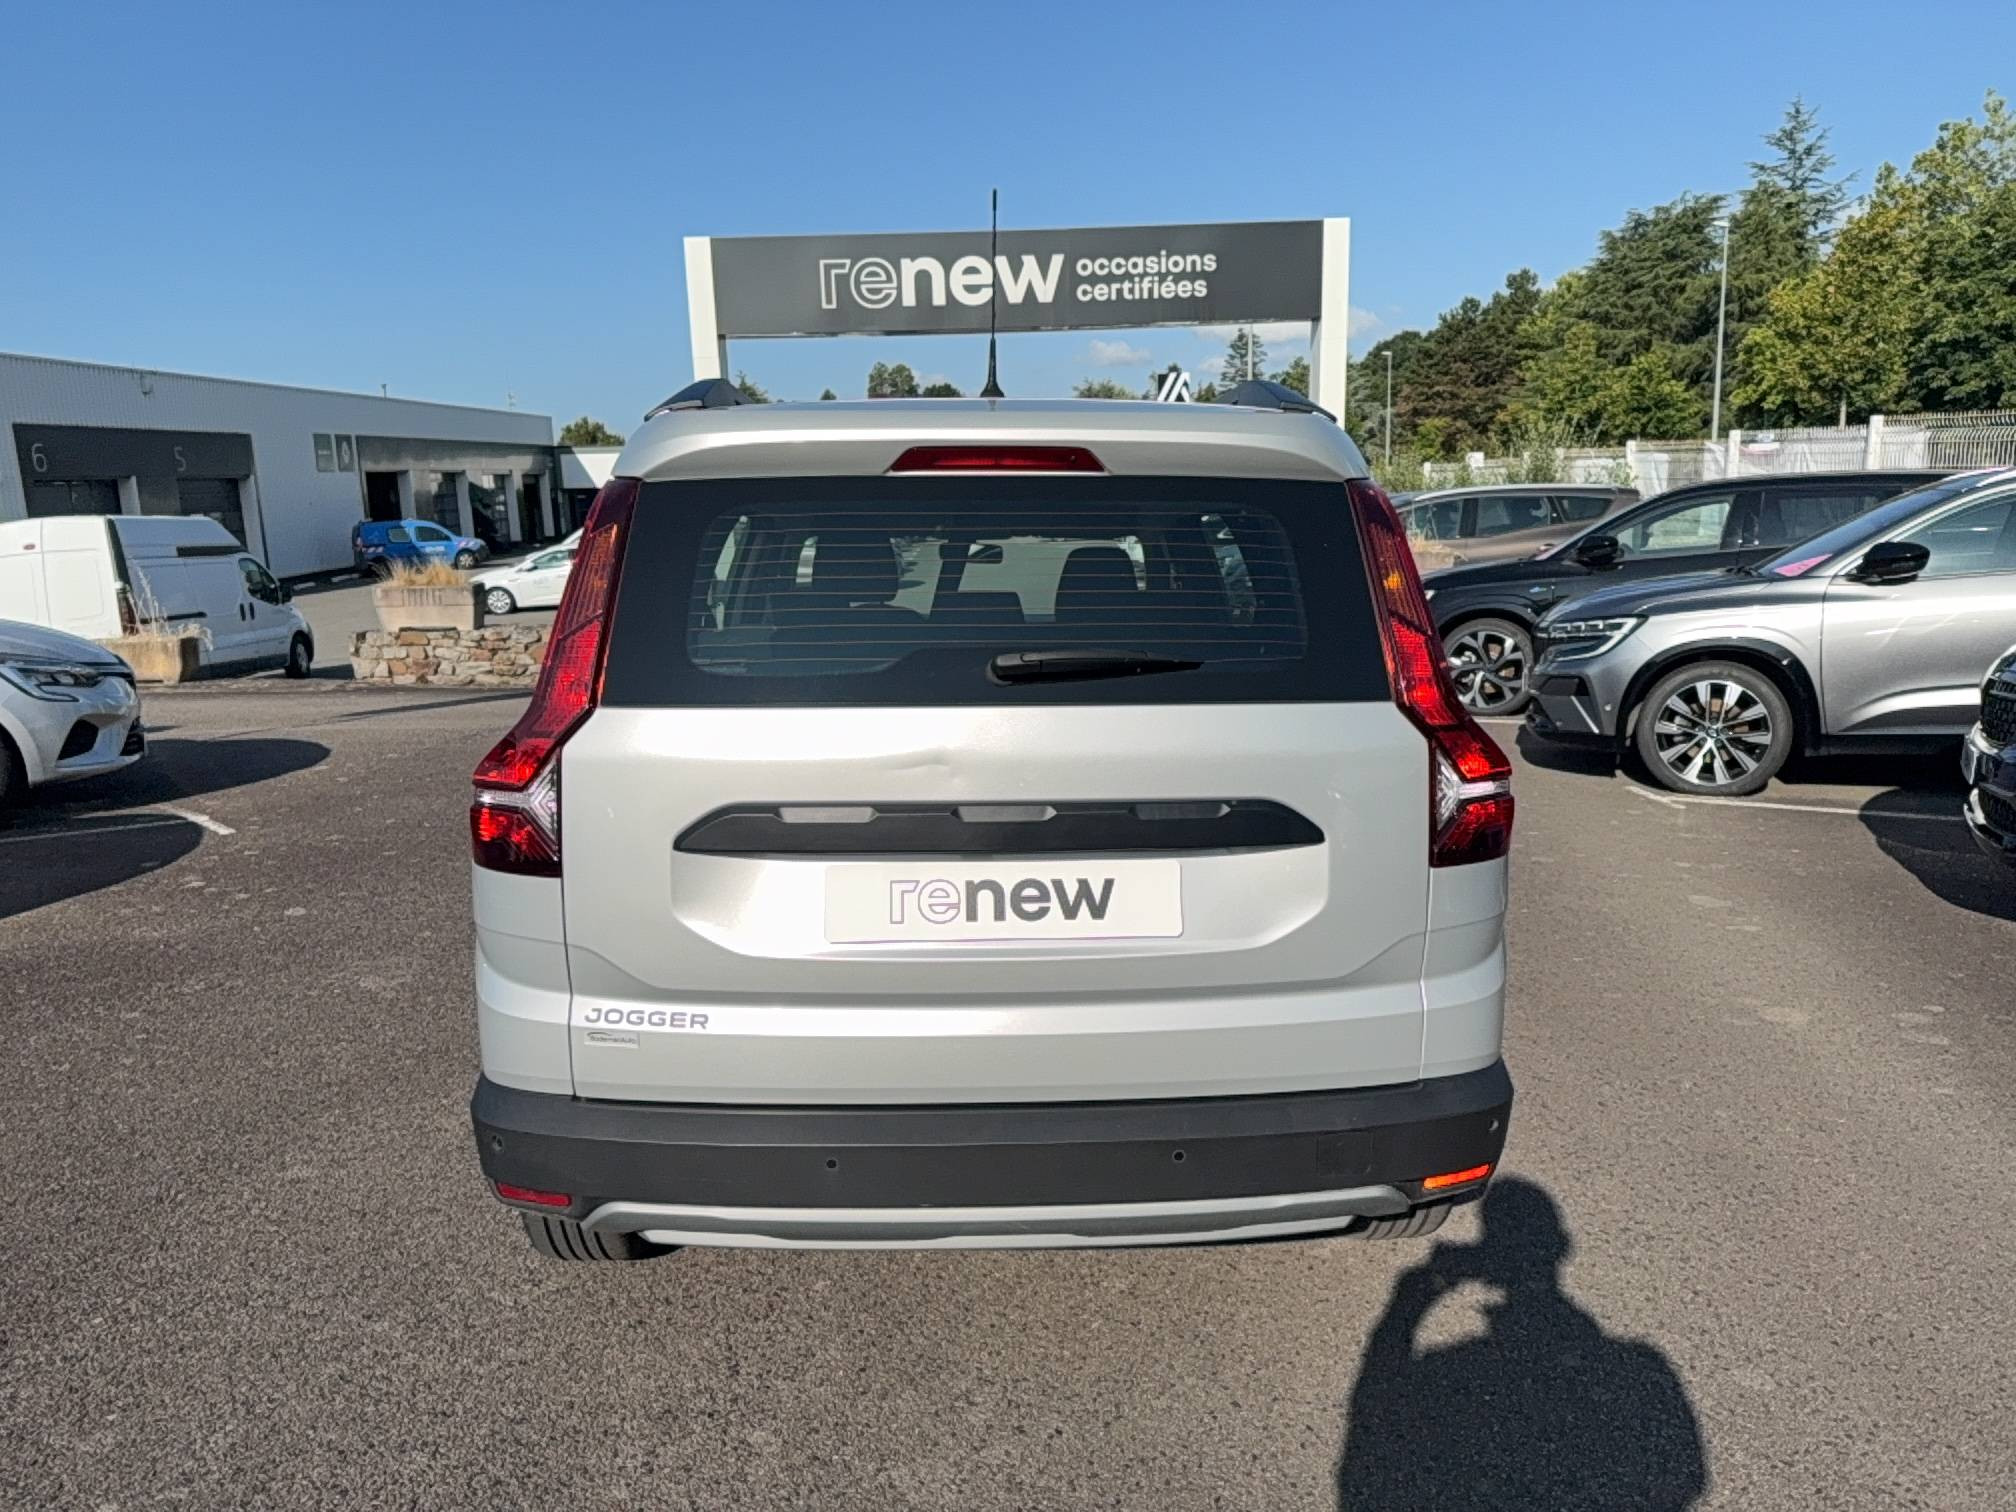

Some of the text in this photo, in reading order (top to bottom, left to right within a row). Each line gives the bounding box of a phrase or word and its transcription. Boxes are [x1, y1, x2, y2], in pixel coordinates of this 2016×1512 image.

[1075, 250, 1218, 277] occasions
[819, 253, 1065, 310] renew
[1075, 276, 1208, 302] certifiées
[31, 443, 48, 472] 6
[174, 446, 187, 472] 5
[889, 877, 1116, 925] renew
[584, 1007, 710, 1030] JOGGER
